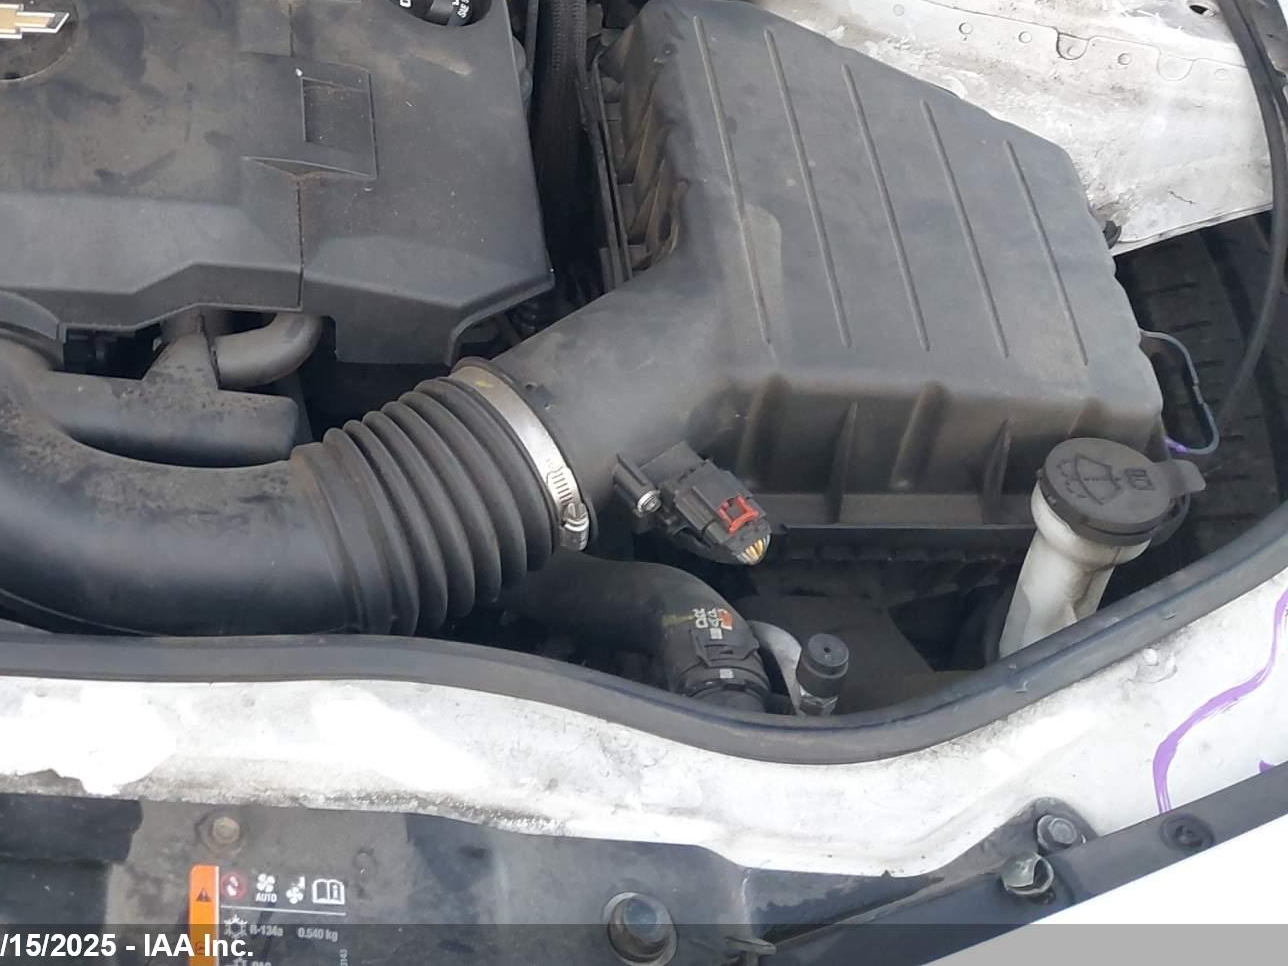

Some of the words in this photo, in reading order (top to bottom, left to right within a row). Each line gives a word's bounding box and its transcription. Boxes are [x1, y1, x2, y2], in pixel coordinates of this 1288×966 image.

[457, 4, 470, 18] SAE
[255, 892, 277, 903] AUTO
[249, 924, 284, 937] R-134a
[325, 928, 338, 942] kg
